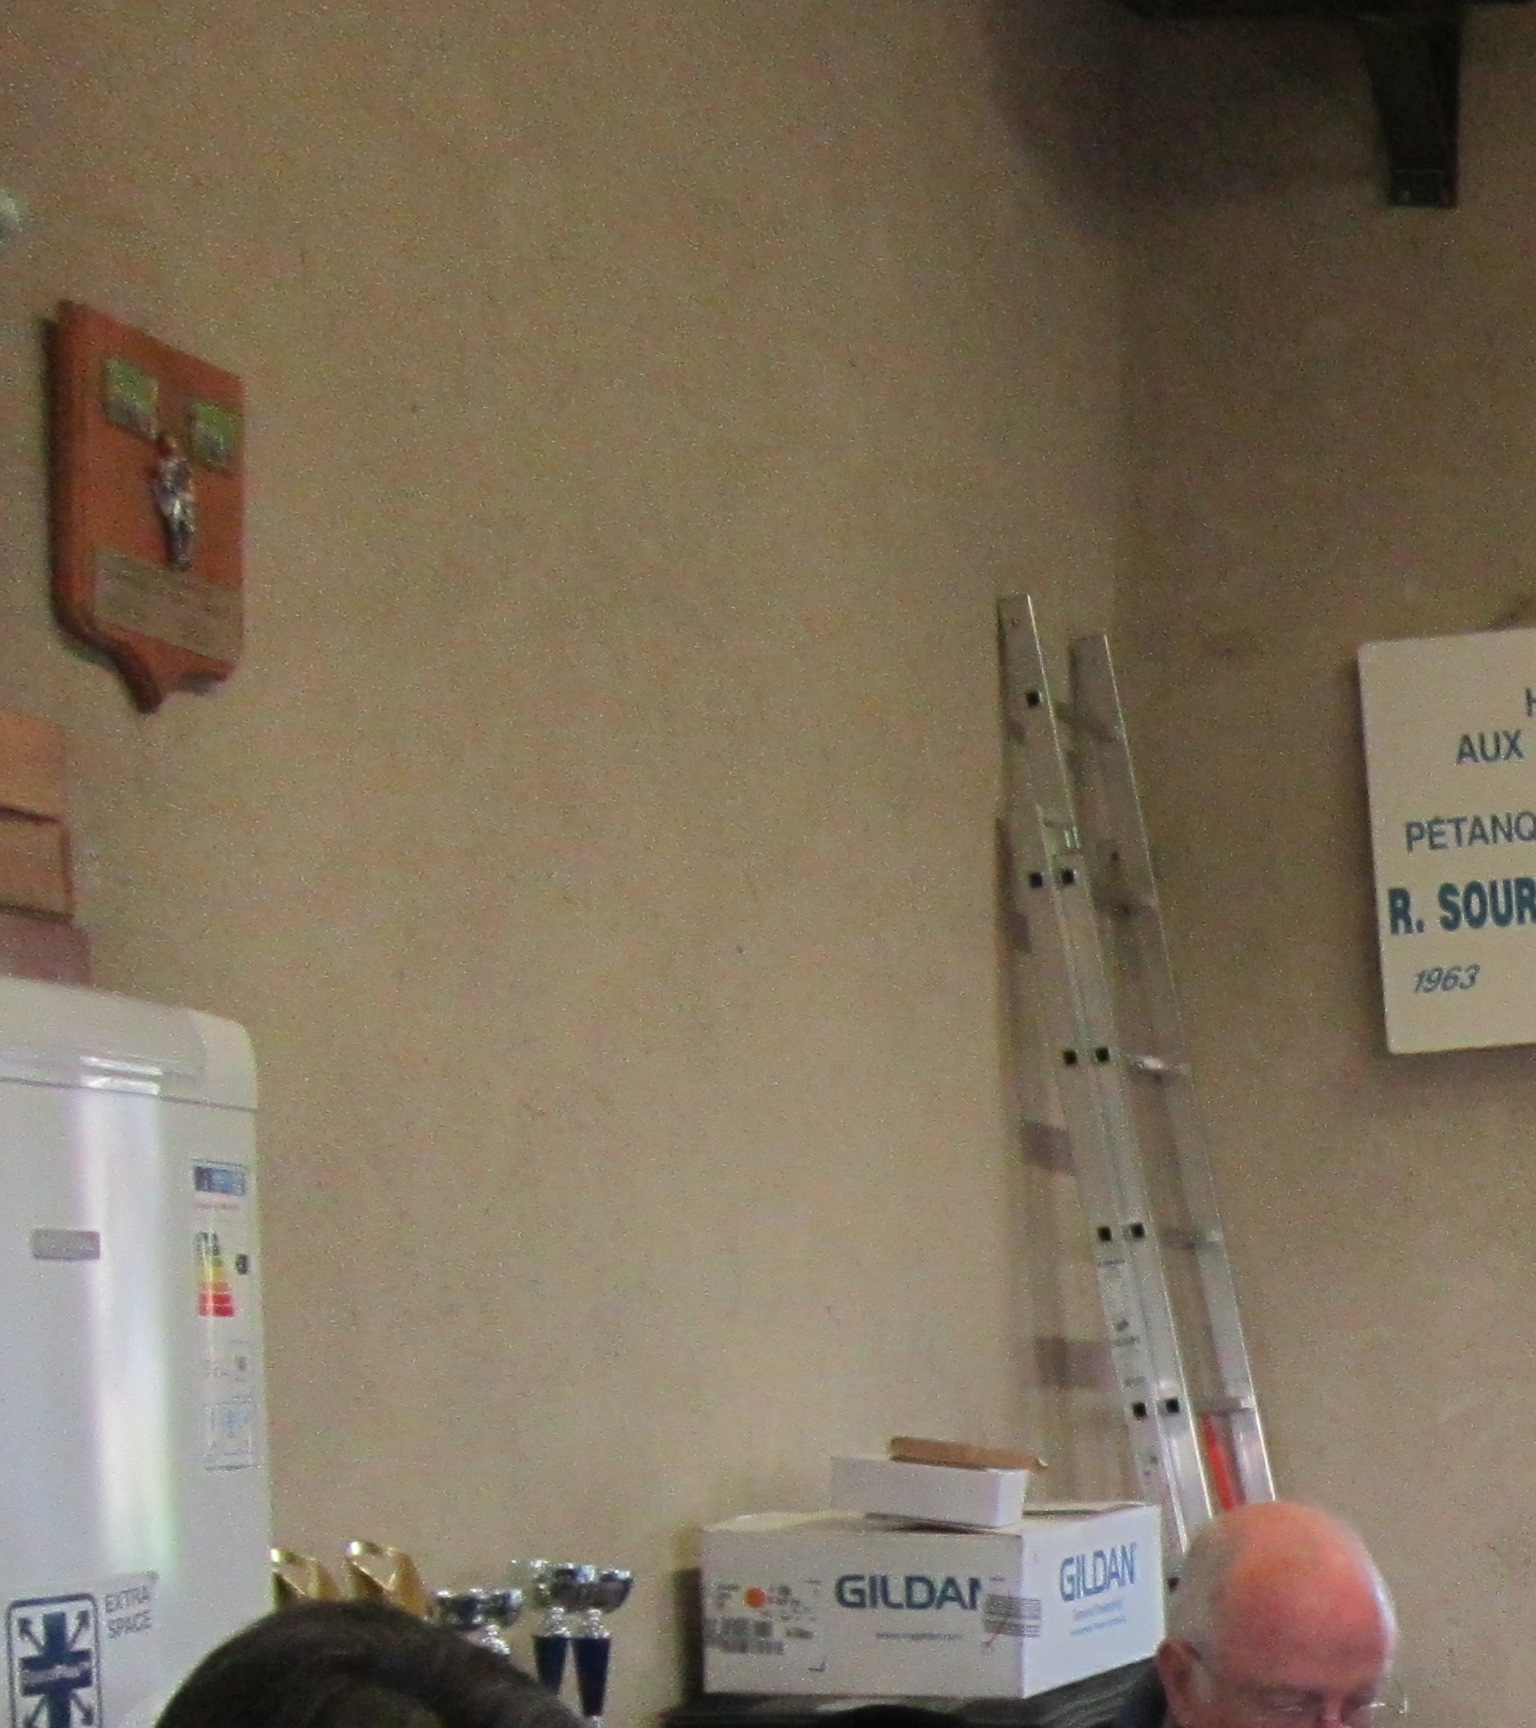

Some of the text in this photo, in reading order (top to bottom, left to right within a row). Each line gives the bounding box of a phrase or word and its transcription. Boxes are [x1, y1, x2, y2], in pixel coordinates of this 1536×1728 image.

[1456, 730, 1524, 766] AUX
[1387, 887, 1425, 935] R.
[1413, 965, 1481, 994] 1963
[1060, 1542, 1136, 1602] GILDAN
[104, 1585, 151, 1613] EXTRA
[106, 1610, 152, 1640] SPACE
